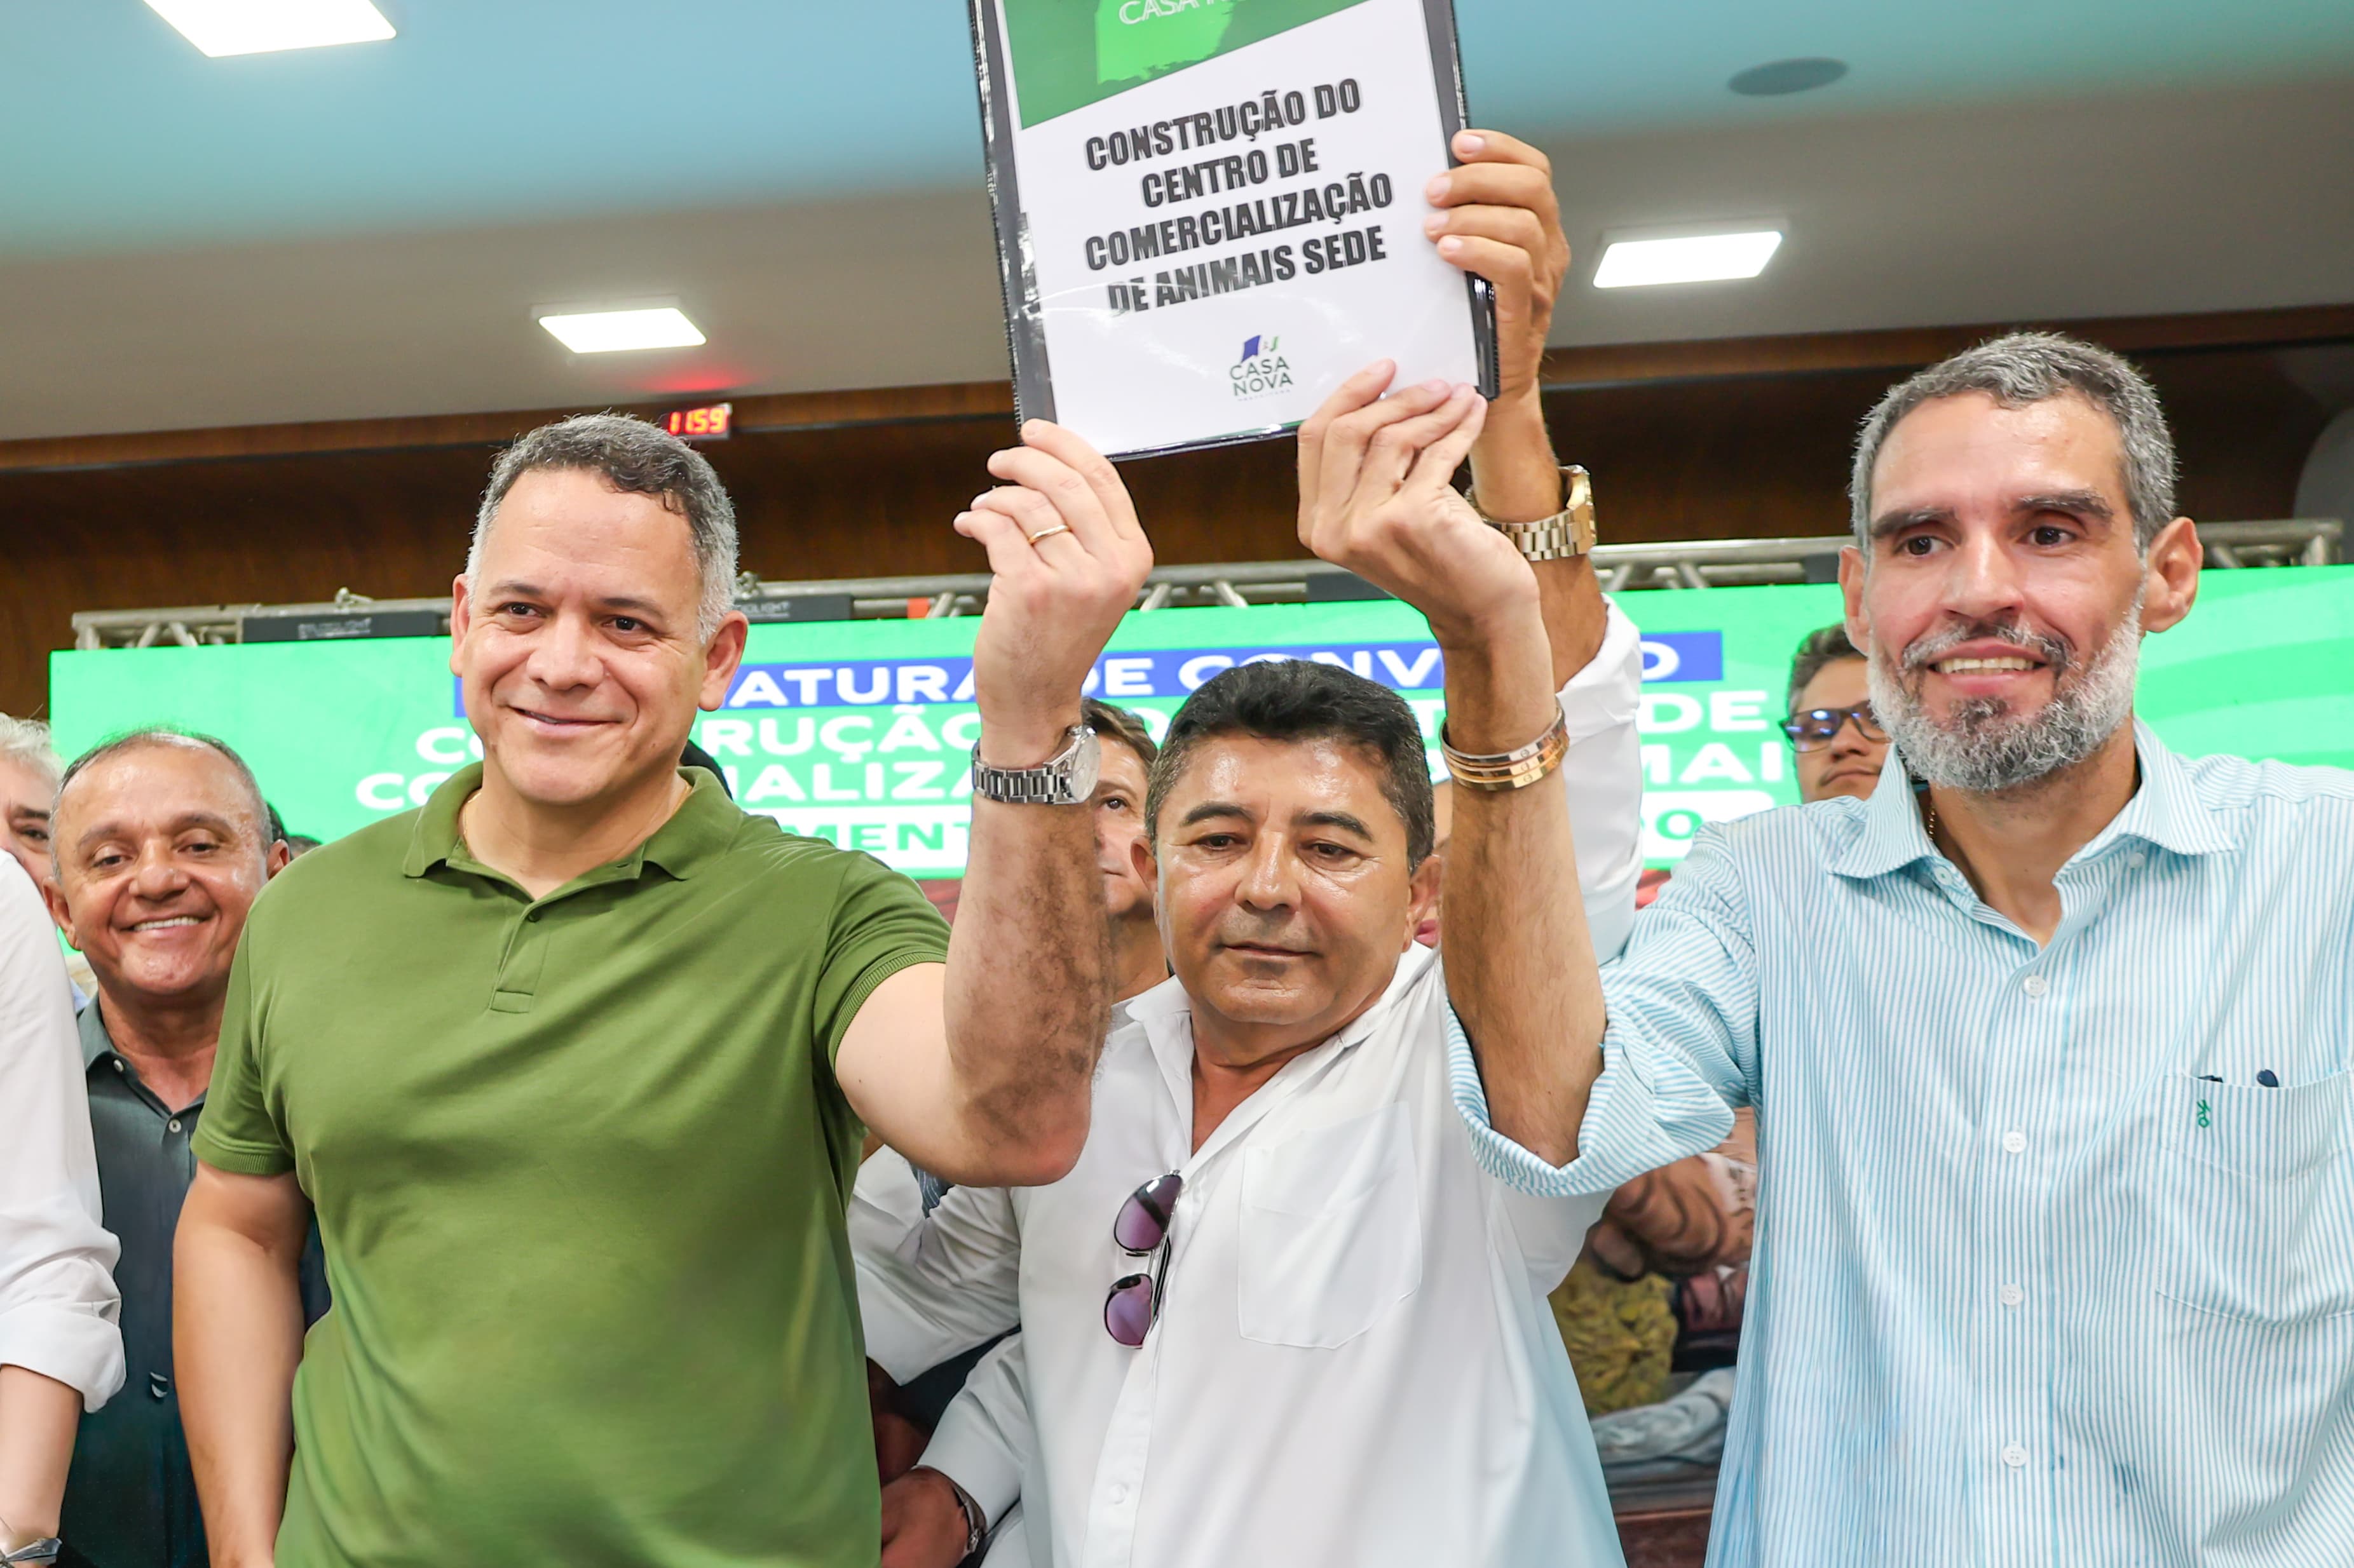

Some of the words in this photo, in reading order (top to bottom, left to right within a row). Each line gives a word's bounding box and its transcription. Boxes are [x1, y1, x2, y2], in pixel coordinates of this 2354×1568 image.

[1086, 90, 1305, 170] CONSTRUÇÃO
[1314, 78, 1361, 119] DO
[1142, 150, 1269, 208] CENTRO
[1276, 138, 1319, 179] DE
[1085, 172, 1394, 271] COMERCIALIZAÇÃO
[1108, 276, 1149, 312] DE
[1155, 245, 1296, 308] ANIMAIS
[1302, 226, 1387, 274] SEDE
[1230, 356, 1290, 380] CASA
[1233, 372, 1294, 396] NOVA
[1637, 690, 1767, 733] DE
